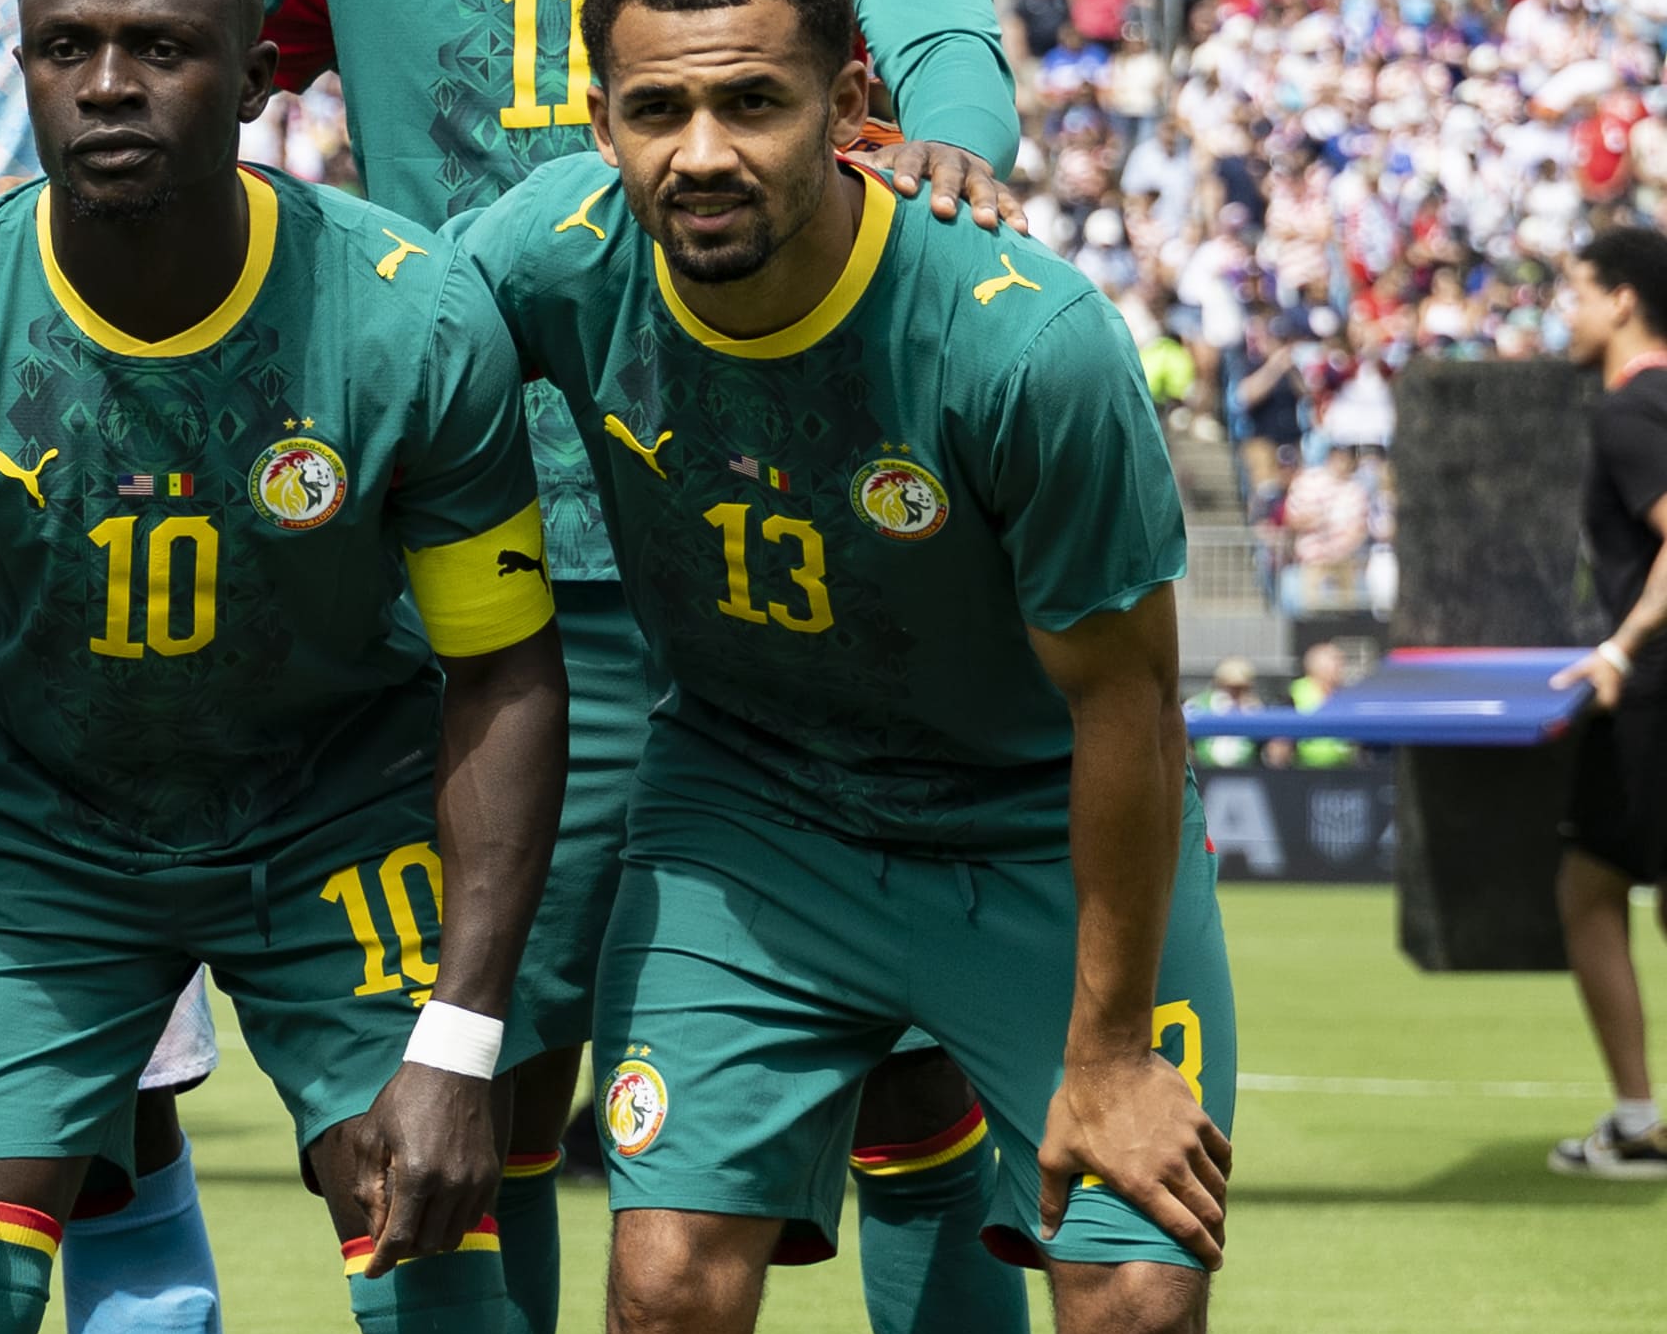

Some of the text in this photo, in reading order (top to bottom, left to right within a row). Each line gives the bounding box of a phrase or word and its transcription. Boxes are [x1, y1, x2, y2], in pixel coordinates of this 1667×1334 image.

[87, 515, 220, 659] 10
[703, 503, 834, 633] 13
[320, 843, 443, 997] 10
